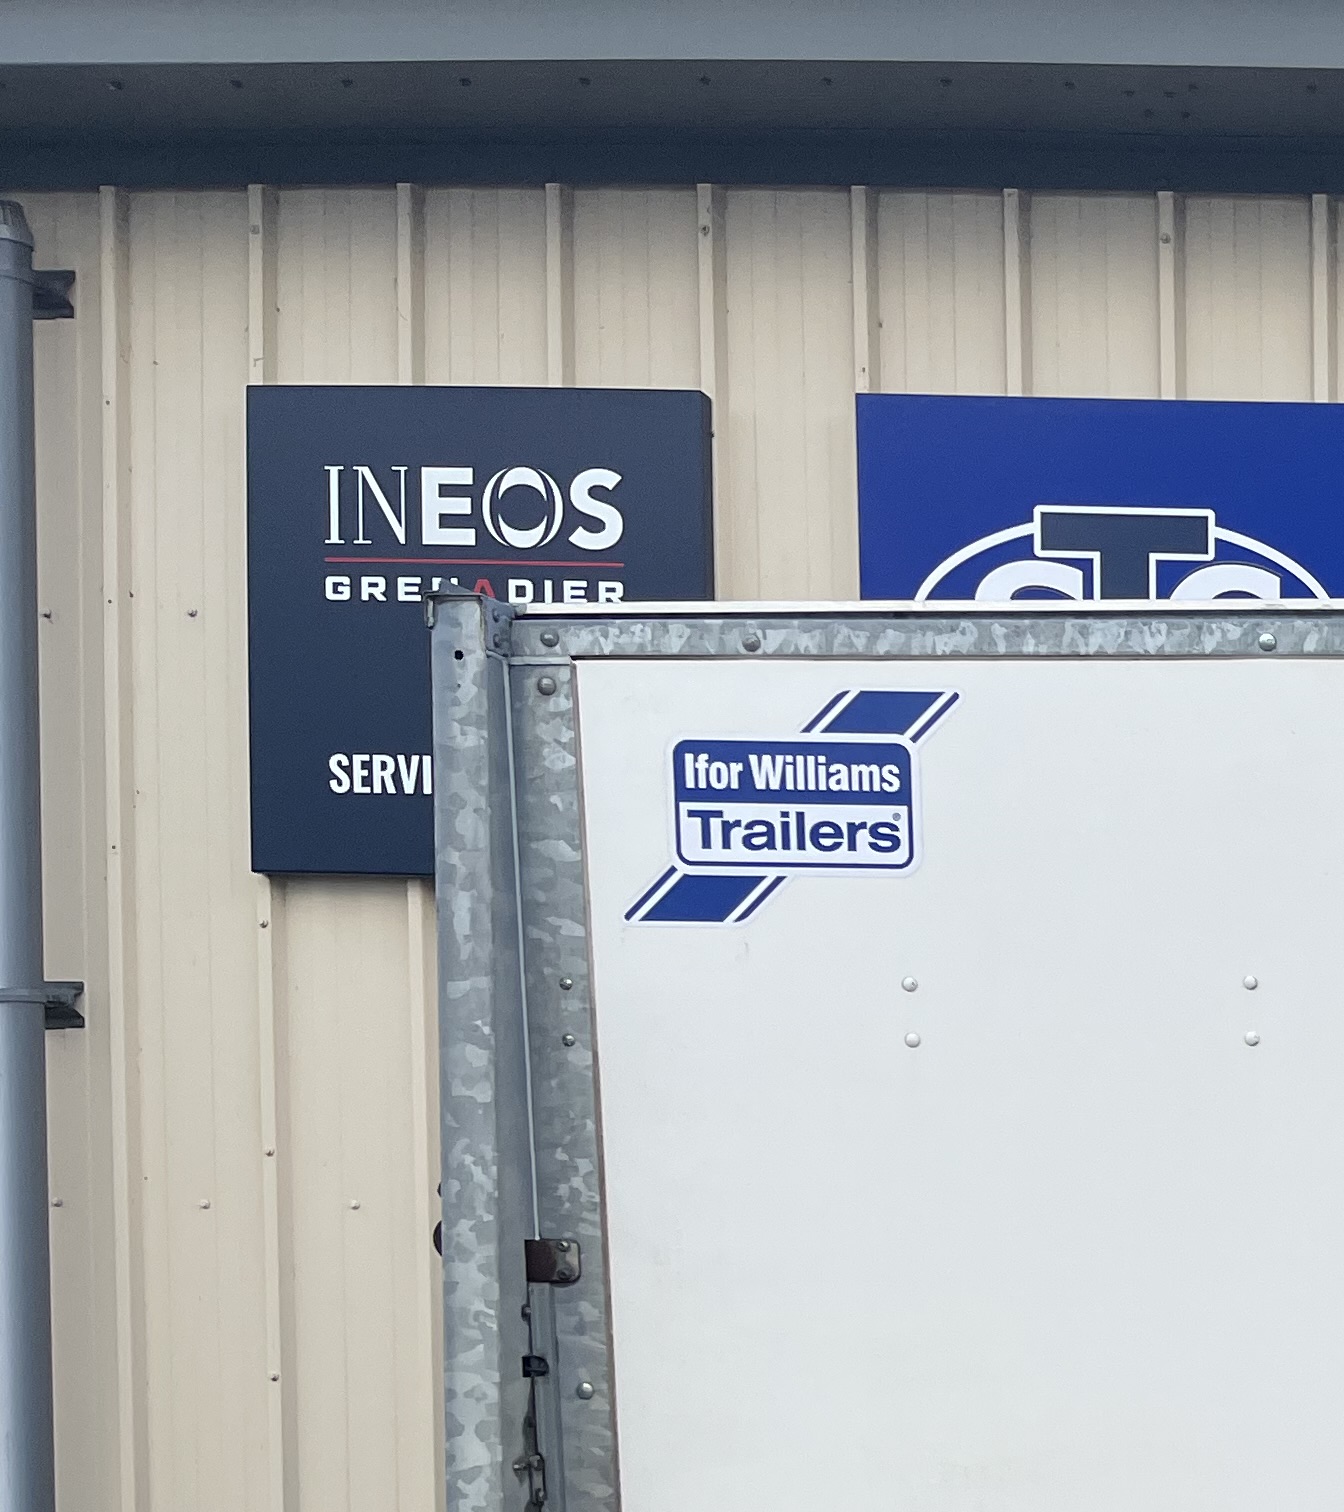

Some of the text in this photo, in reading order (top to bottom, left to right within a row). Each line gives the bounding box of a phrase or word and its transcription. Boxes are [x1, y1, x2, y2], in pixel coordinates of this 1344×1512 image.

[324, 465, 624, 550] INEOS
[328, 753, 433, 795] SERVI
[684, 753, 901, 792] Ifor Williams
[687, 809, 902, 853] Trailers
